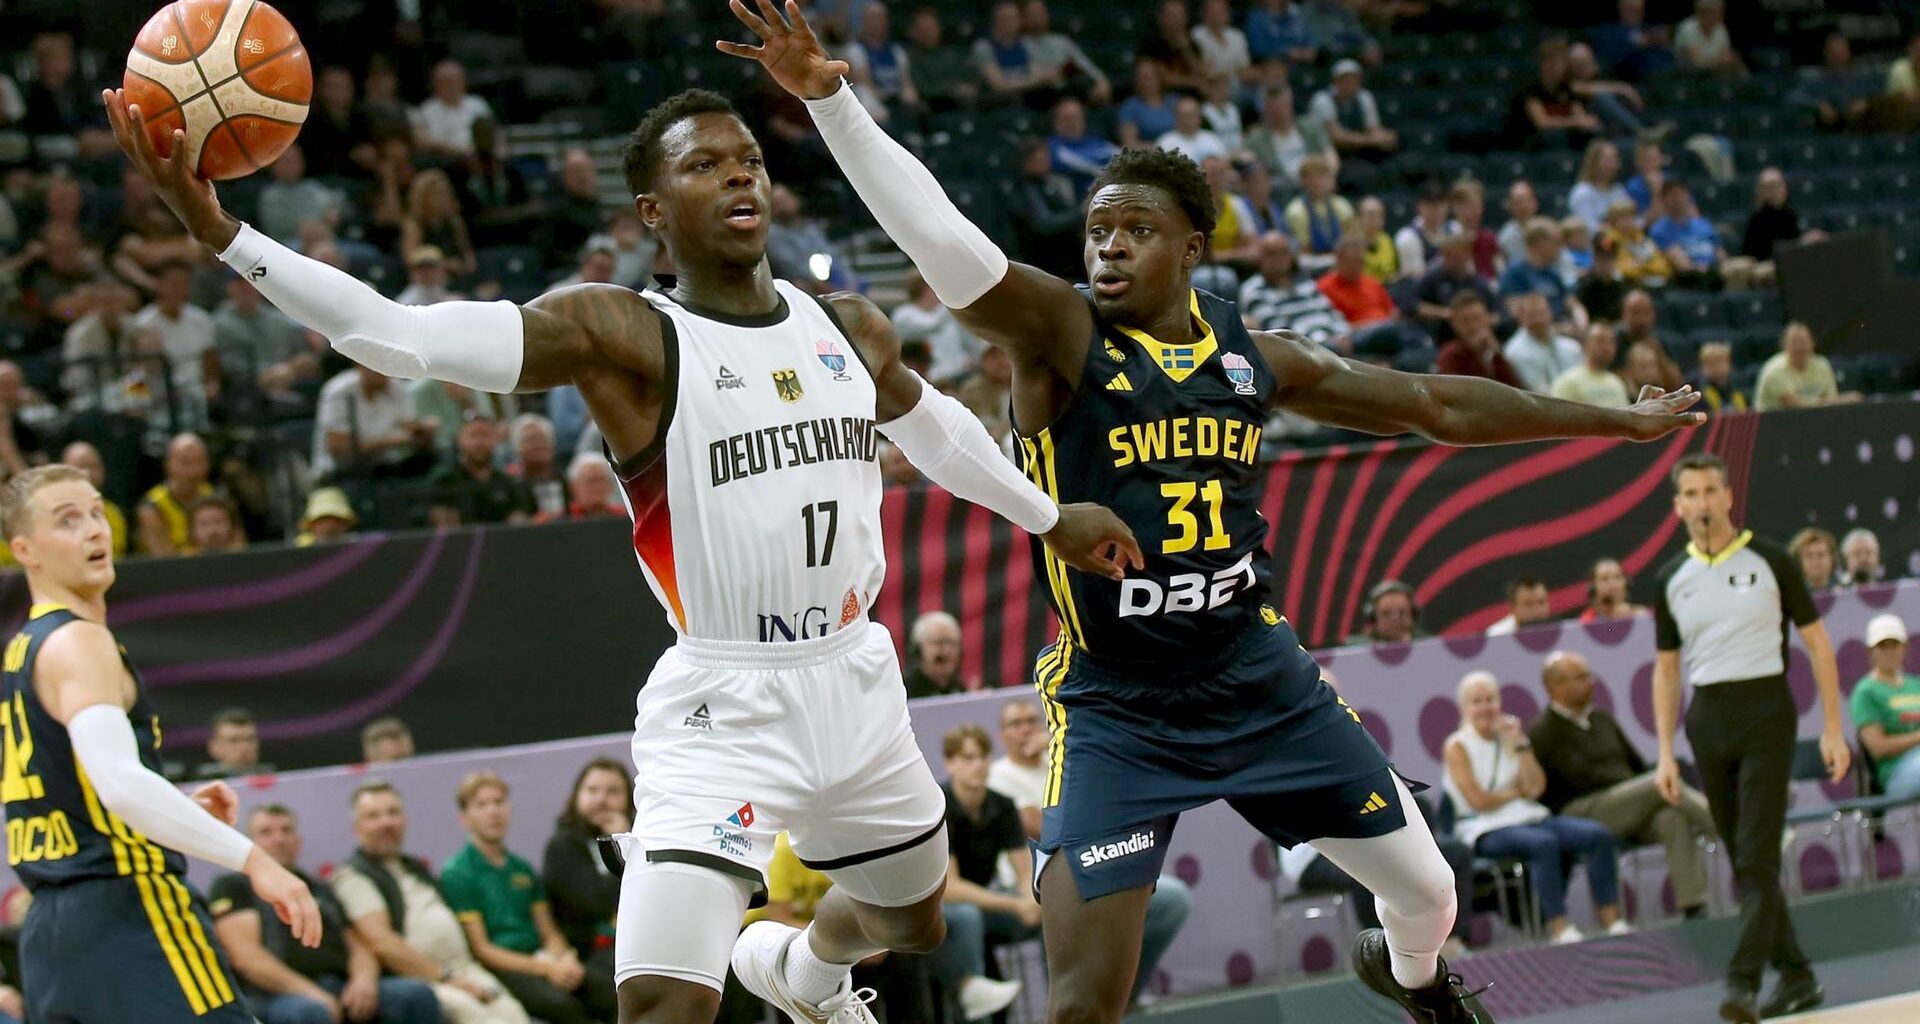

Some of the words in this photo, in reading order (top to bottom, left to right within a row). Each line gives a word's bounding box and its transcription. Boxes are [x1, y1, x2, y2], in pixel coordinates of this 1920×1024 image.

[709, 417, 877, 488] DEUTSCHLAND
[1108, 417, 1262, 468] SWEDEN
[802, 500, 838, 568] 17
[1160, 479, 1231, 554] 31
[757, 606, 831, 643] ING
